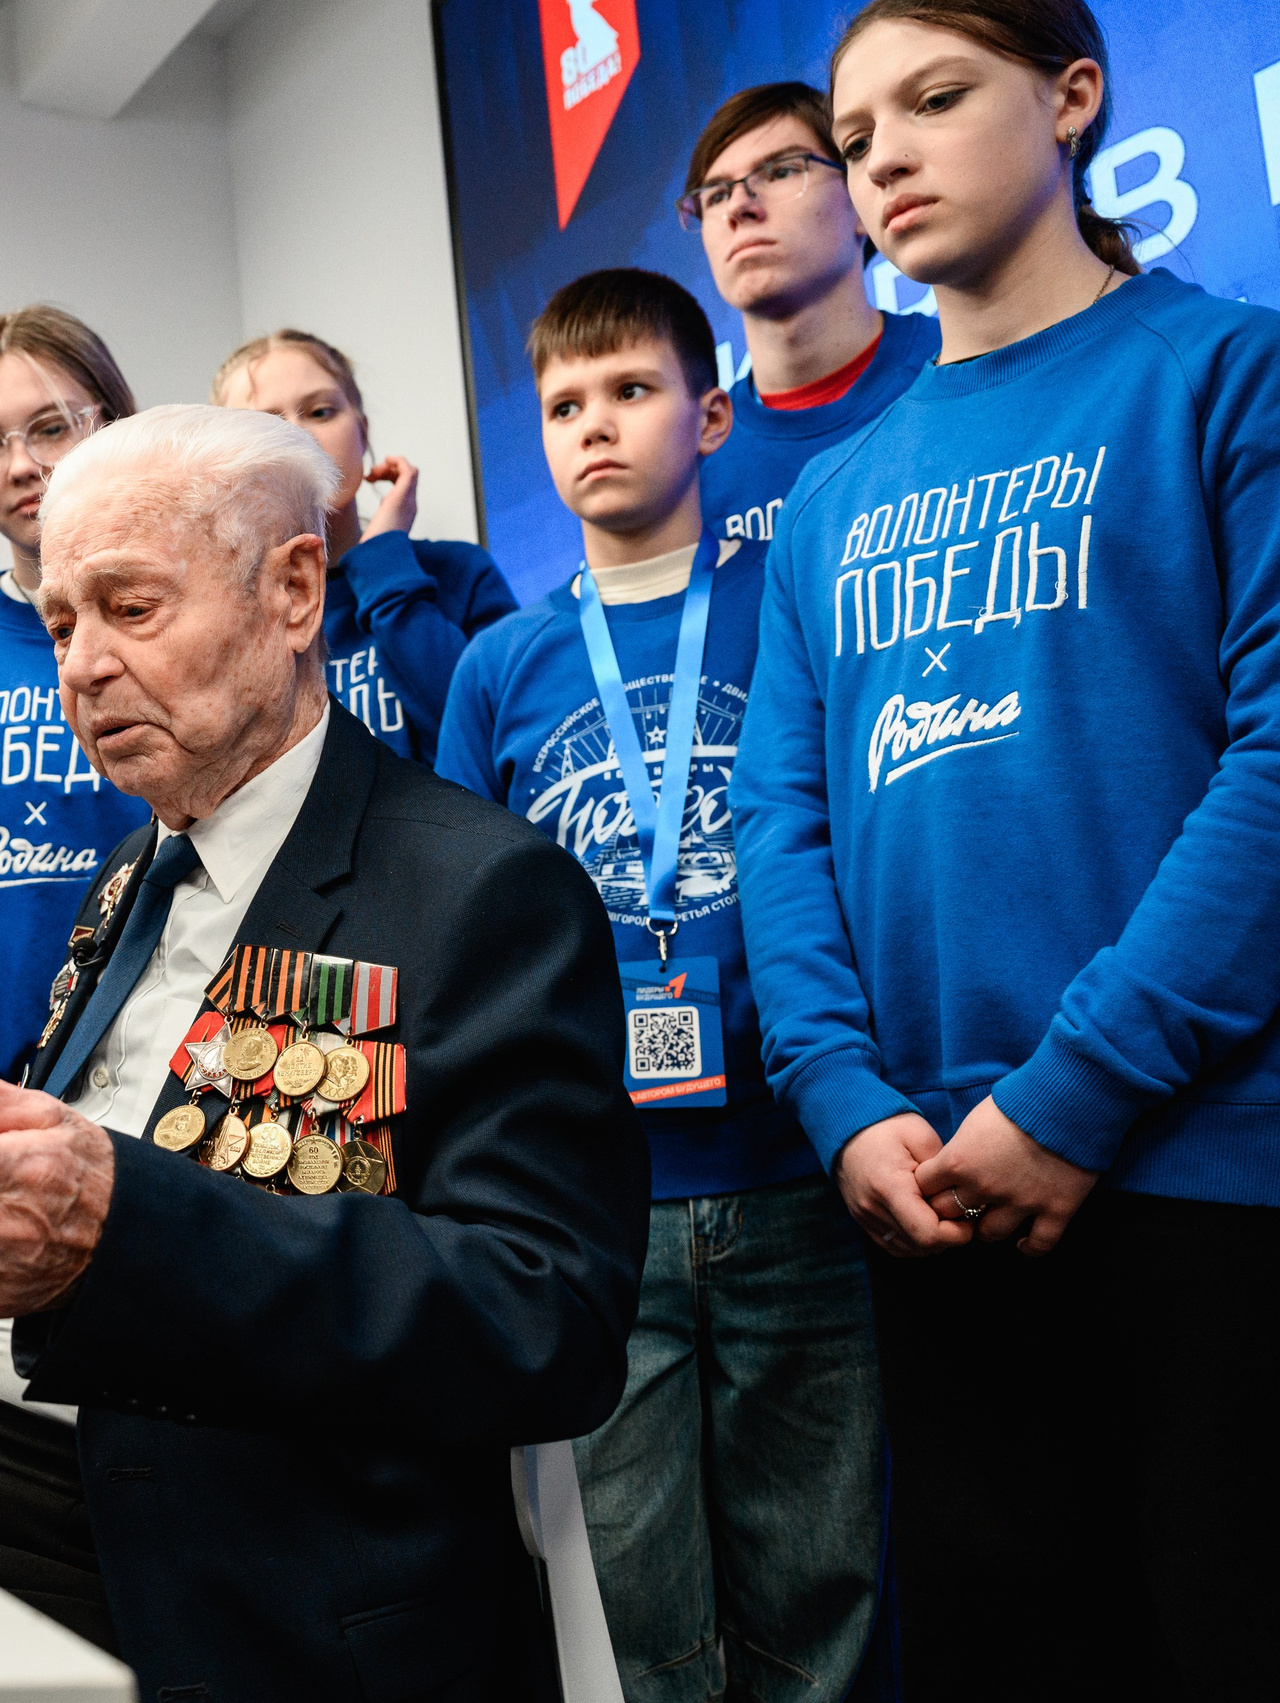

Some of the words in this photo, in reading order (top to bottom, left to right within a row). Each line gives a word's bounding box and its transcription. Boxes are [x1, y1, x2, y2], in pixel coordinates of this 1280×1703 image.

[840, 446, 1106, 567] ВОЛОНТЕРЫ
[834, 515, 1093, 658] ПОБЕДЫ
[532, 697, 600, 772] ВСЕРОССИЙСКОЕ
[868, 691, 1022, 794] Родина
